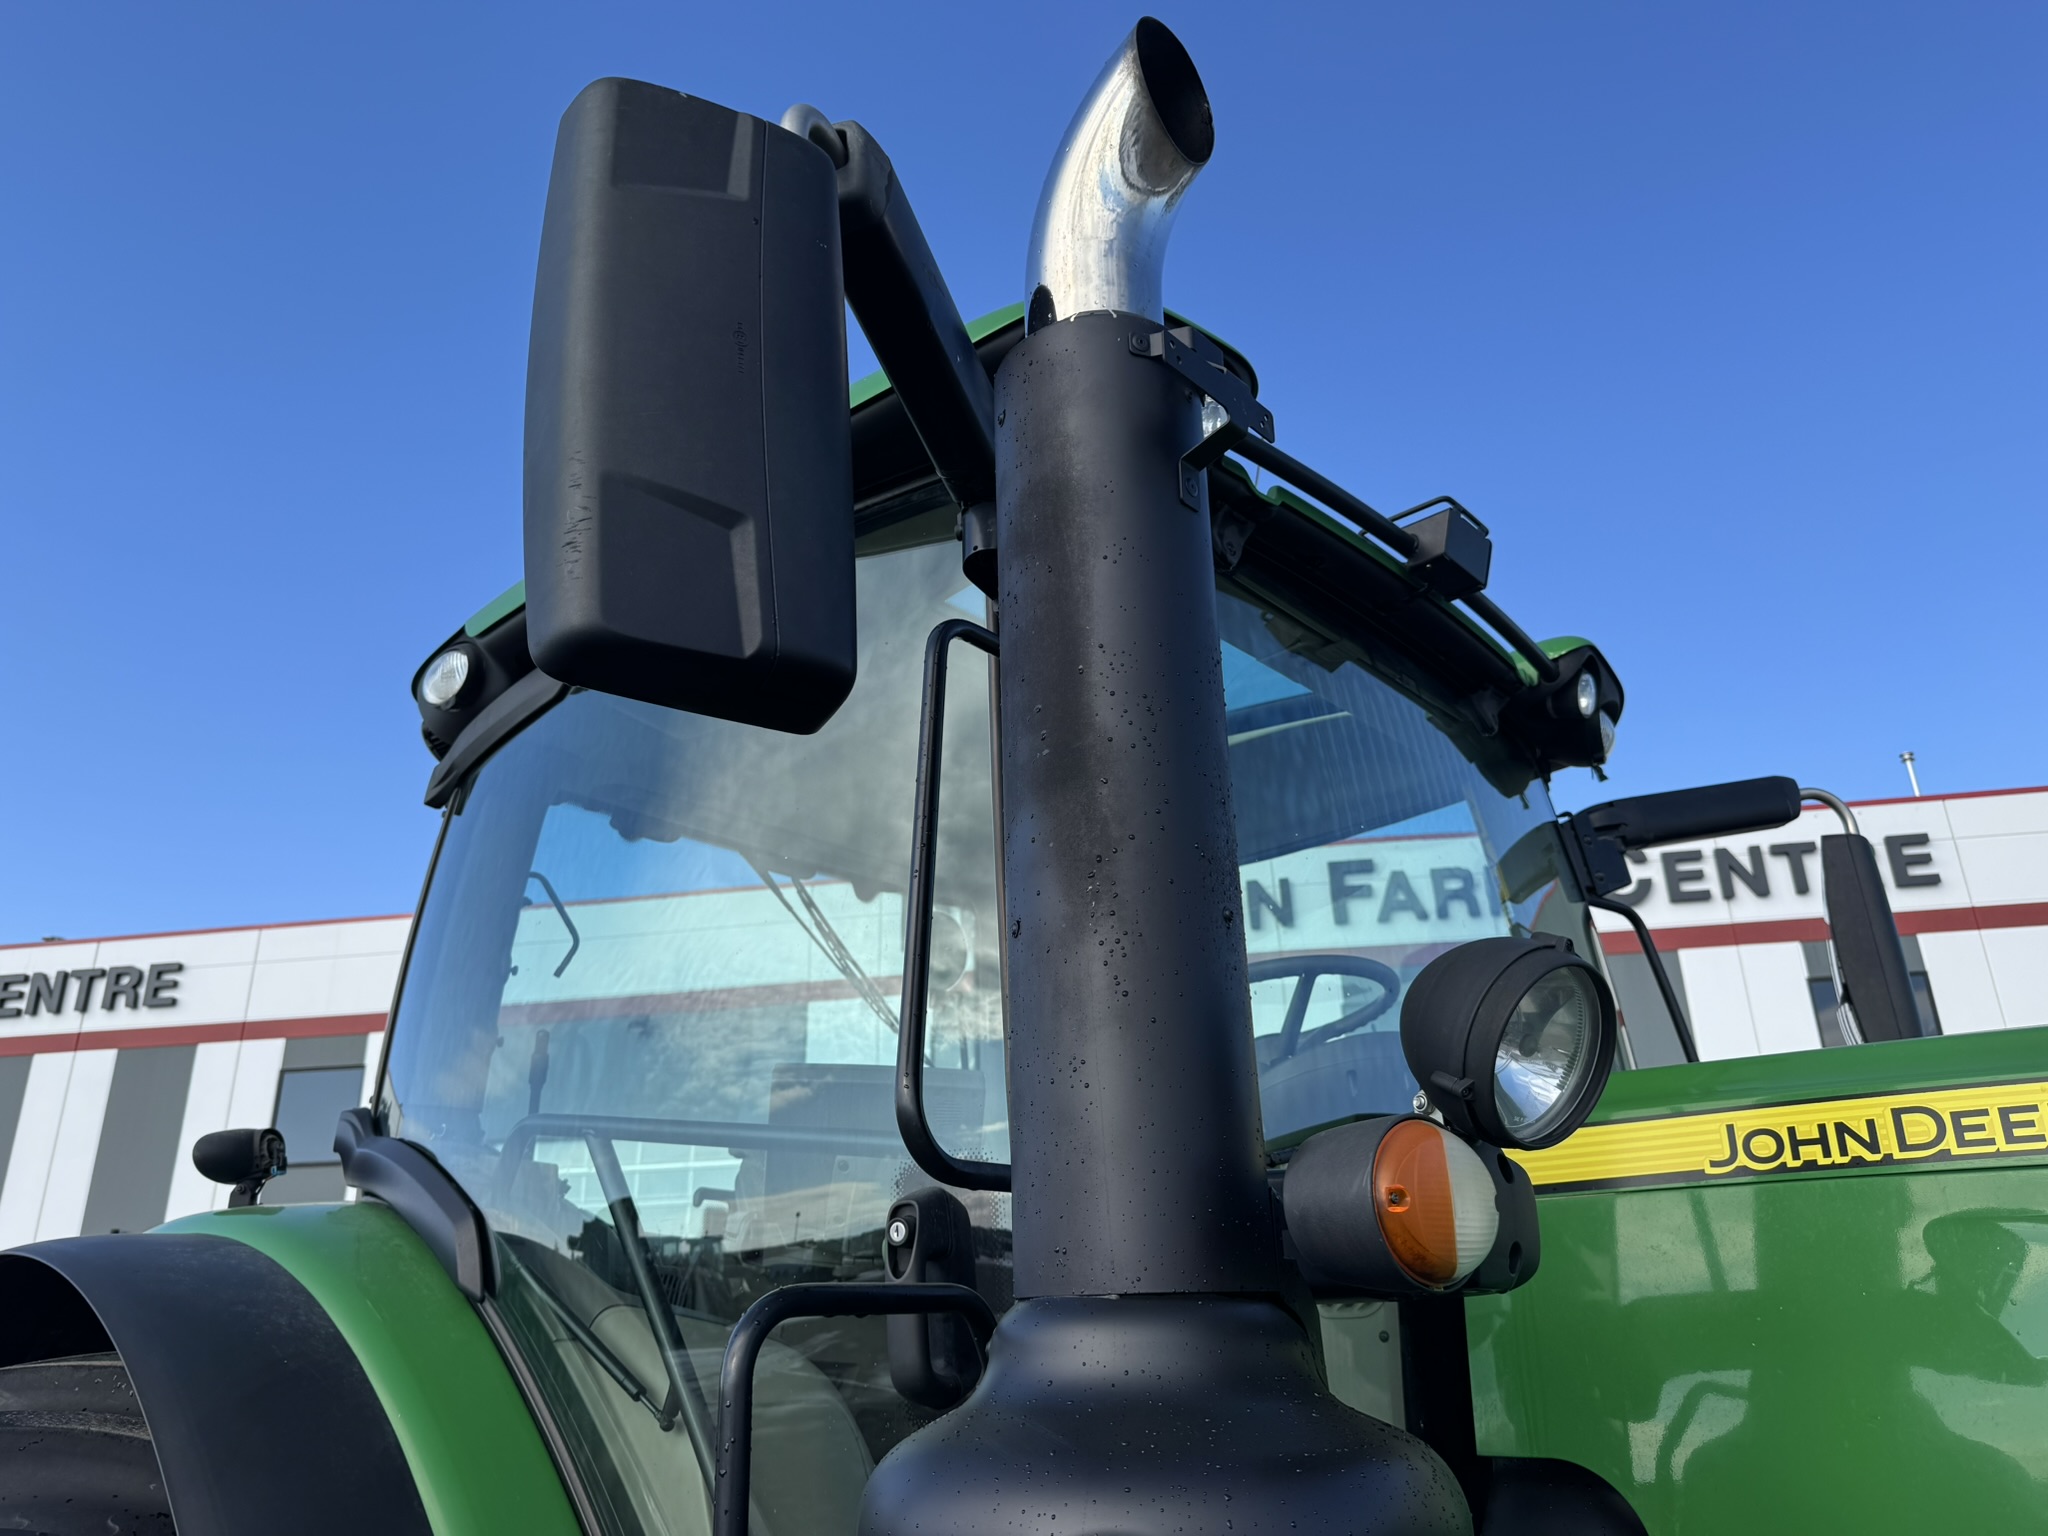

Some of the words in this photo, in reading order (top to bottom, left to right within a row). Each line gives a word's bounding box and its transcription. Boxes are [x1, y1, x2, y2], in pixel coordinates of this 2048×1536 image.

[1601, 832, 1942, 908] CENTE
[0, 962, 184, 1018] ENTRE
[1707, 1117, 1882, 1168] JOHN
